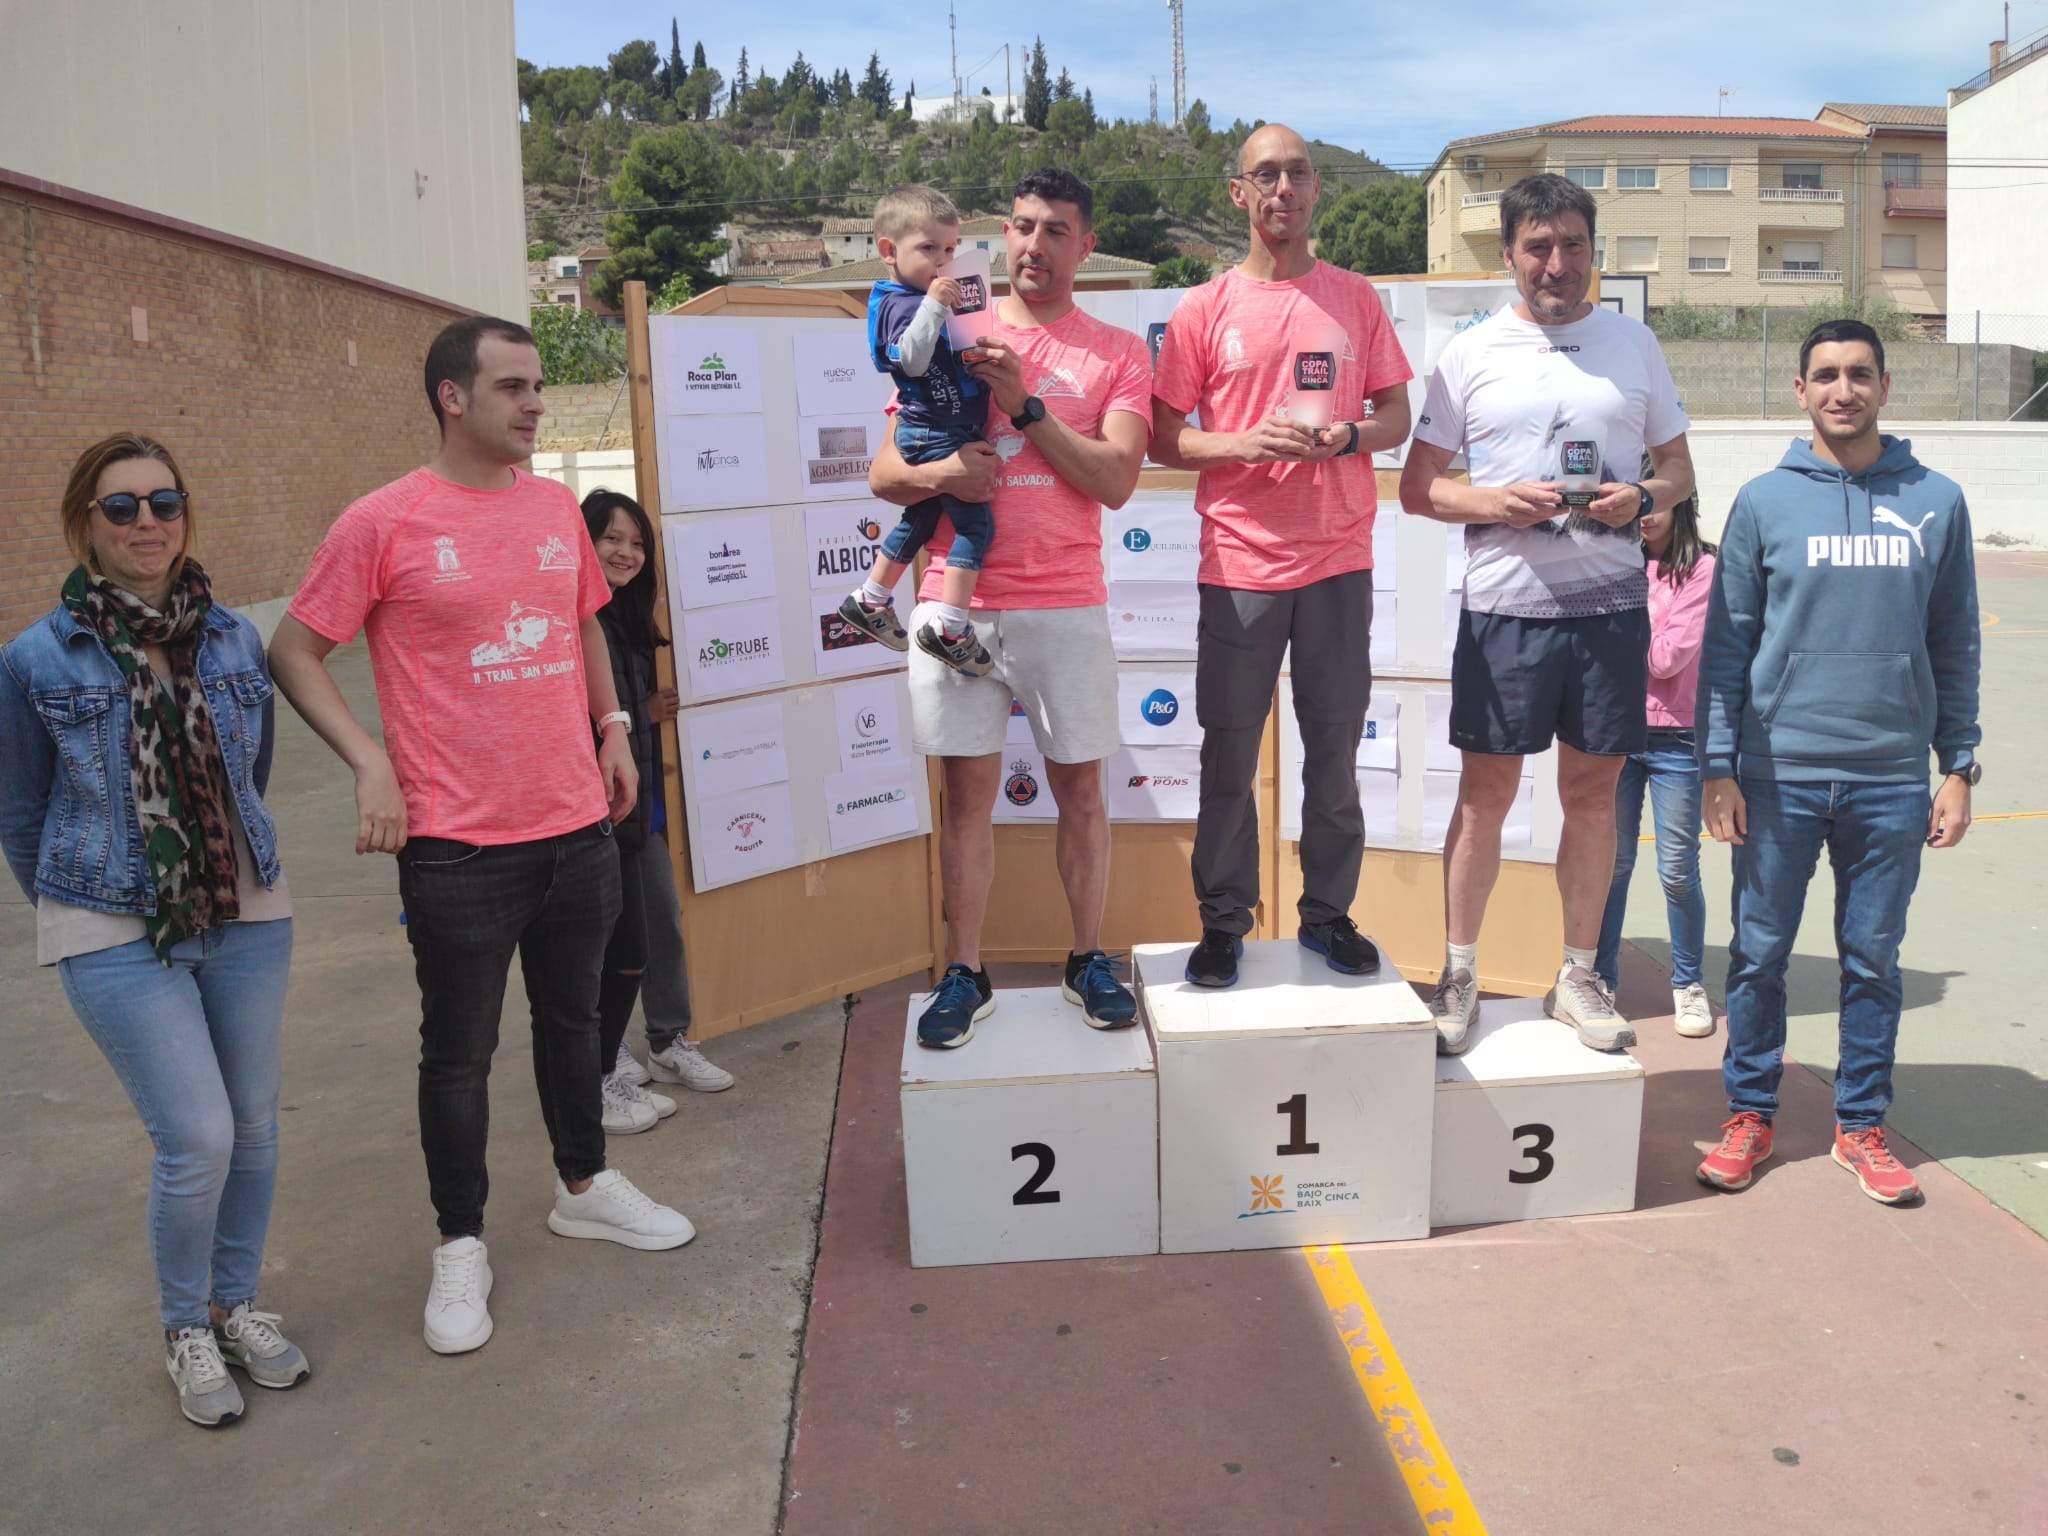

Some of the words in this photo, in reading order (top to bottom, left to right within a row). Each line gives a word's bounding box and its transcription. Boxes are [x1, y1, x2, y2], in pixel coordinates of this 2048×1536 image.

[957, 283, 979, 293] OPA
[958, 290, 980, 300] RAIL
[1301, 360, 1329, 368] COPA
[687, 370, 712, 382] Roca
[714, 370, 737, 381] Plan
[1302, 367, 1329, 375] TRAIL
[1006, 474, 1057, 487] SALVADOR
[1807, 534, 1911, 568] PUMA
[484, 668, 517, 683] TRAIL
[520, 665, 541, 680] SAN
[1148, 701, 1176, 714] P&G
[1152, 778, 1189, 787] PONS
[846, 792, 894, 812] FARMACIA
[1276, 1093, 1320, 1156] 1
[1508, 1123, 1554, 1184] 3
[1011, 1142, 1061, 1206] 2
[1296, 1190, 1322, 1198] BAJO
[1324, 1192, 1360, 1201] CINCA
[1296, 1199, 1322, 1208] BAIX
